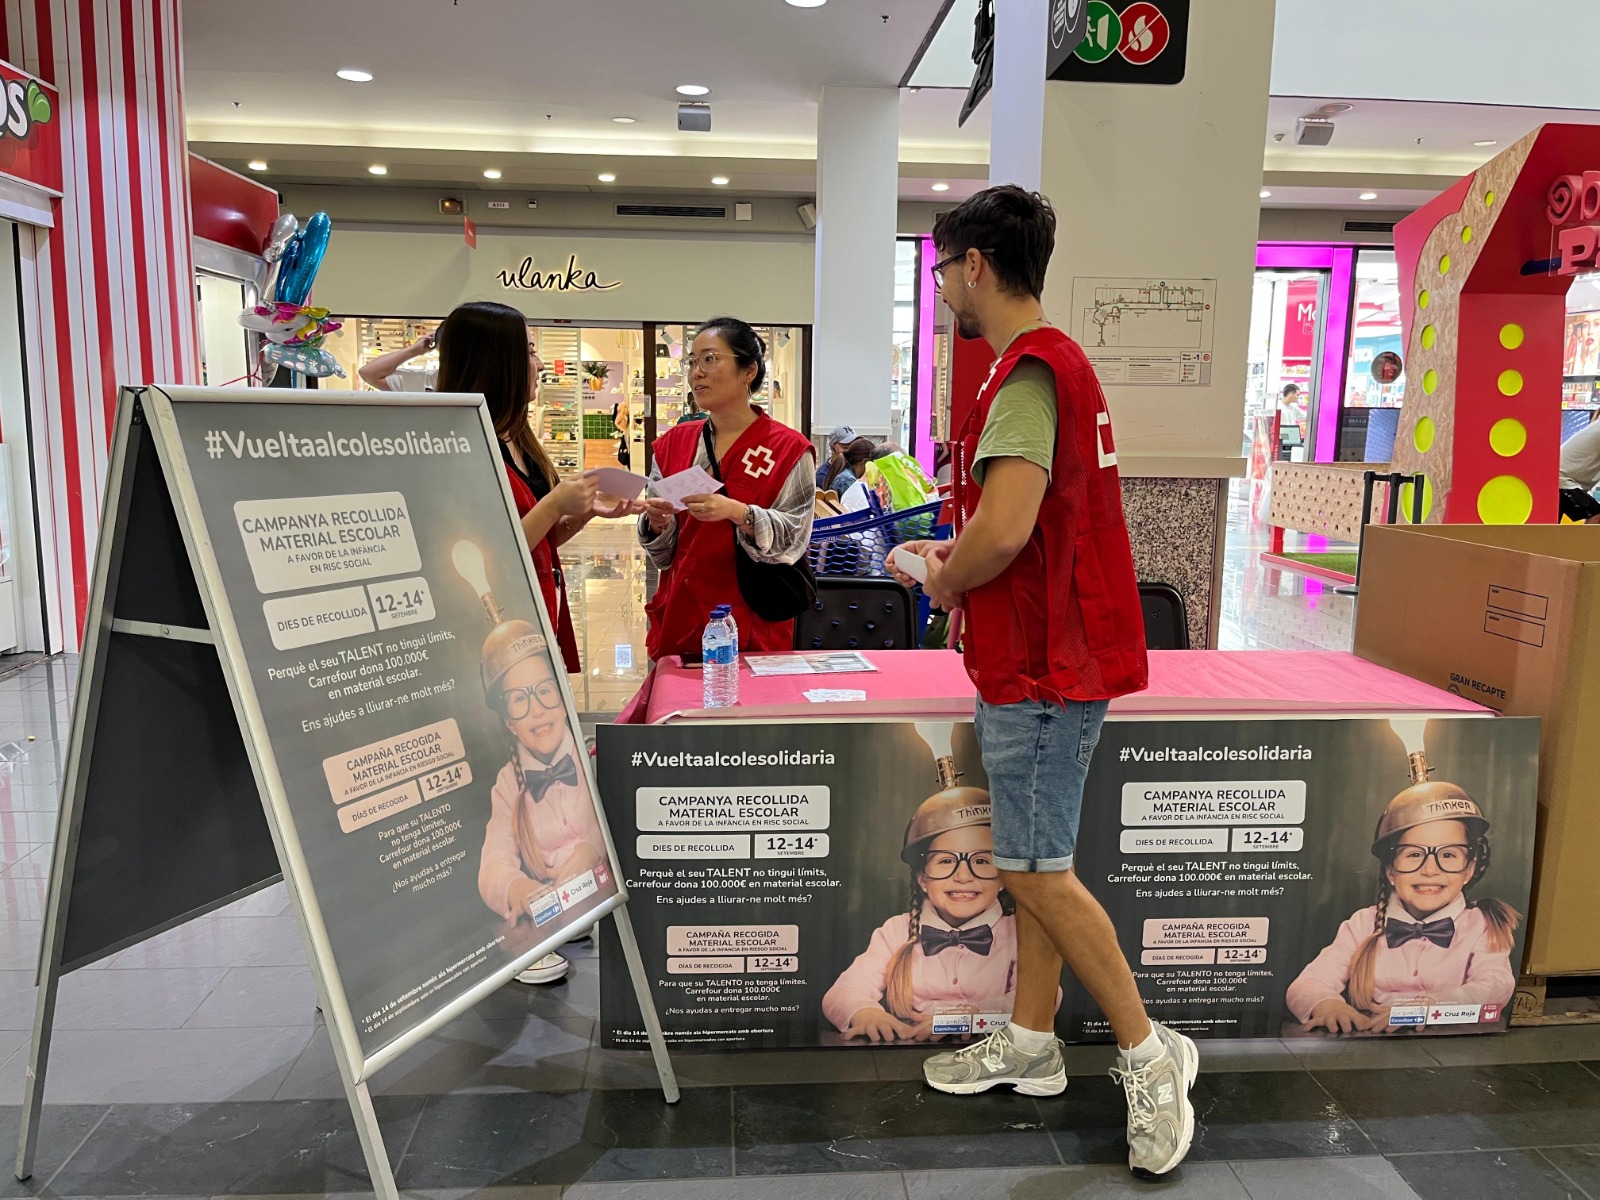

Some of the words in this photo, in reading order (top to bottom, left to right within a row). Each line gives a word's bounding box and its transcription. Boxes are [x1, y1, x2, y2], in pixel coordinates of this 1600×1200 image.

[1558, 226, 1600, 275] P
[496, 255, 621, 291] ulanka
[205, 430, 471, 459] #Vueltaalcolesolidaria
[242, 513, 329, 534] CAMPANYA
[330, 507, 406, 526] RECOLLIDA
[259, 531, 337, 552] MATERIAL
[338, 524, 401, 543] ESCOLAR
[287, 555, 295, 564] A
[295, 551, 324, 563] FAVOR
[324, 550, 337, 559] DE
[337, 548, 349, 557] LA
[350, 544, 387, 556] INFÀNCIA
[309, 564, 322, 573] EN
[322, 561, 342, 571] RISC
[343, 558, 372, 569] SOCIAL
[277, 618, 300, 632] DIES
[301, 616, 315, 627] DE
[316, 607, 368, 624] RECOLLIDA
[391, 608, 418, 619] SETEMBRE
[267, 661, 306, 680] Perquè
[308, 658, 319, 671] el
[320, 657, 339, 669] seu
[337, 643, 383, 664] TALENT
[386, 643, 398, 653] no
[399, 634, 426, 650] tingui
[308, 669, 357, 688] Carrefour
[359, 663, 384, 676] dona
[384, 649, 429, 670] 100.000€
[328, 689, 342, 700] en
[343, 676, 385, 696] material
[386, 668, 422, 684] escolar.
[1450, 672, 1471, 687] GRAN
[1471, 680, 1506, 700] RECAPTE
[301, 719, 321, 732] Ens
[323, 709, 357, 727] ajudes
[358, 707, 365, 716] a
[365, 694, 409, 714] lliurar-ne
[410, 686, 433, 700] molt
[433, 678, 455, 694] més?
[346, 747, 394, 771] CAMPAÑA
[394, 731, 441, 755] RECOGIDA
[631, 749, 835, 767] #Vueltaalcolesolidaria
[1119, 744, 1312, 762] #Vueltaalcolesolidaria
[352, 759, 400, 783] MATERIAL
[399, 743, 442, 766] ESCOLAR
[659, 795, 733, 806] CAMPANYA
[736, 794, 809, 805] RECOLLIDA
[1143, 790, 1213, 800] CAMPANYA
[1217, 789, 1286, 800] RECOLLIDA
[352, 810, 368, 822] DÍAS
[368, 806, 378, 815] DE
[377, 794, 409, 811] RECOGIDA
[669, 808, 735, 818] MATERIAL
[739, 807, 798, 818] ESCOLAR
[1153, 802, 1215, 813] MATERIAL
[1218, 801, 1275, 812] ESCOLAR
[378, 828, 395, 840] Para
[396, 822, 410, 833] que
[410, 818, 419, 827] su
[418, 803, 451, 822] TALENTO
[379, 844, 412, 863] Carrefour
[413, 836, 430, 848] dona
[431, 820, 462, 840] 100.000€
[391, 838, 401, 847] no
[401, 829, 421, 842] tenga
[420, 818, 446, 833] límites,
[393, 860, 402, 869] en
[402, 845, 431, 865] material
[431, 835, 457, 851] escolar.
[652, 844, 672, 852] DIES
[674, 844, 685, 852] DE
[687, 844, 734, 852] RECOLLIDA
[640, 868, 674, 879] Perquè
[676, 869, 686, 878] el
[705, 867, 751, 877] TALENT
[767, 867, 795, 878] tingui
[1121, 862, 1154, 873] Perquè
[1156, 863, 1165, 871] el
[1185, 861, 1228, 871] TALENT
[1242, 861, 1269, 872] tingui
[625, 879, 672, 888] Carrefour
[674, 880, 698, 888] dona
[701, 879, 746, 888] 100.000€
[763, 878, 803, 888] material
[805, 878, 842, 887] escolar.
[1107, 874, 1152, 883] Carrefour
[1153, 873, 1176, 882] dona
[1178, 872, 1222, 882] 100.000€
[1238, 872, 1276, 880] material
[1278, 871, 1313, 880] escolar.
[570, 885, 583, 896] Cruz
[582, 879, 593, 889] Roja
[1136, 889, 1152, 898] Ens
[1154, 888, 1184, 898] ajudes
[1194, 888, 1236, 896] lliurar-ne
[1237, 887, 1259, 896] molt
[1260, 886, 1284, 896] més?
[656, 895, 674, 904] Ens
[676, 895, 707, 906] ajudes
[717, 895, 761, 904] lliurar-ne
[763, 894, 786, 903] molt
[788, 894, 812, 903] més?
[686, 929, 731, 938] CAMPAÑA
[733, 930, 780, 938] RECOGIDA
[1162, 922, 1204, 931] CAMPAÑA
[1208, 930, 1247, 938] ESCOLAR
[735, 938, 776, 946] ESCOLAR
